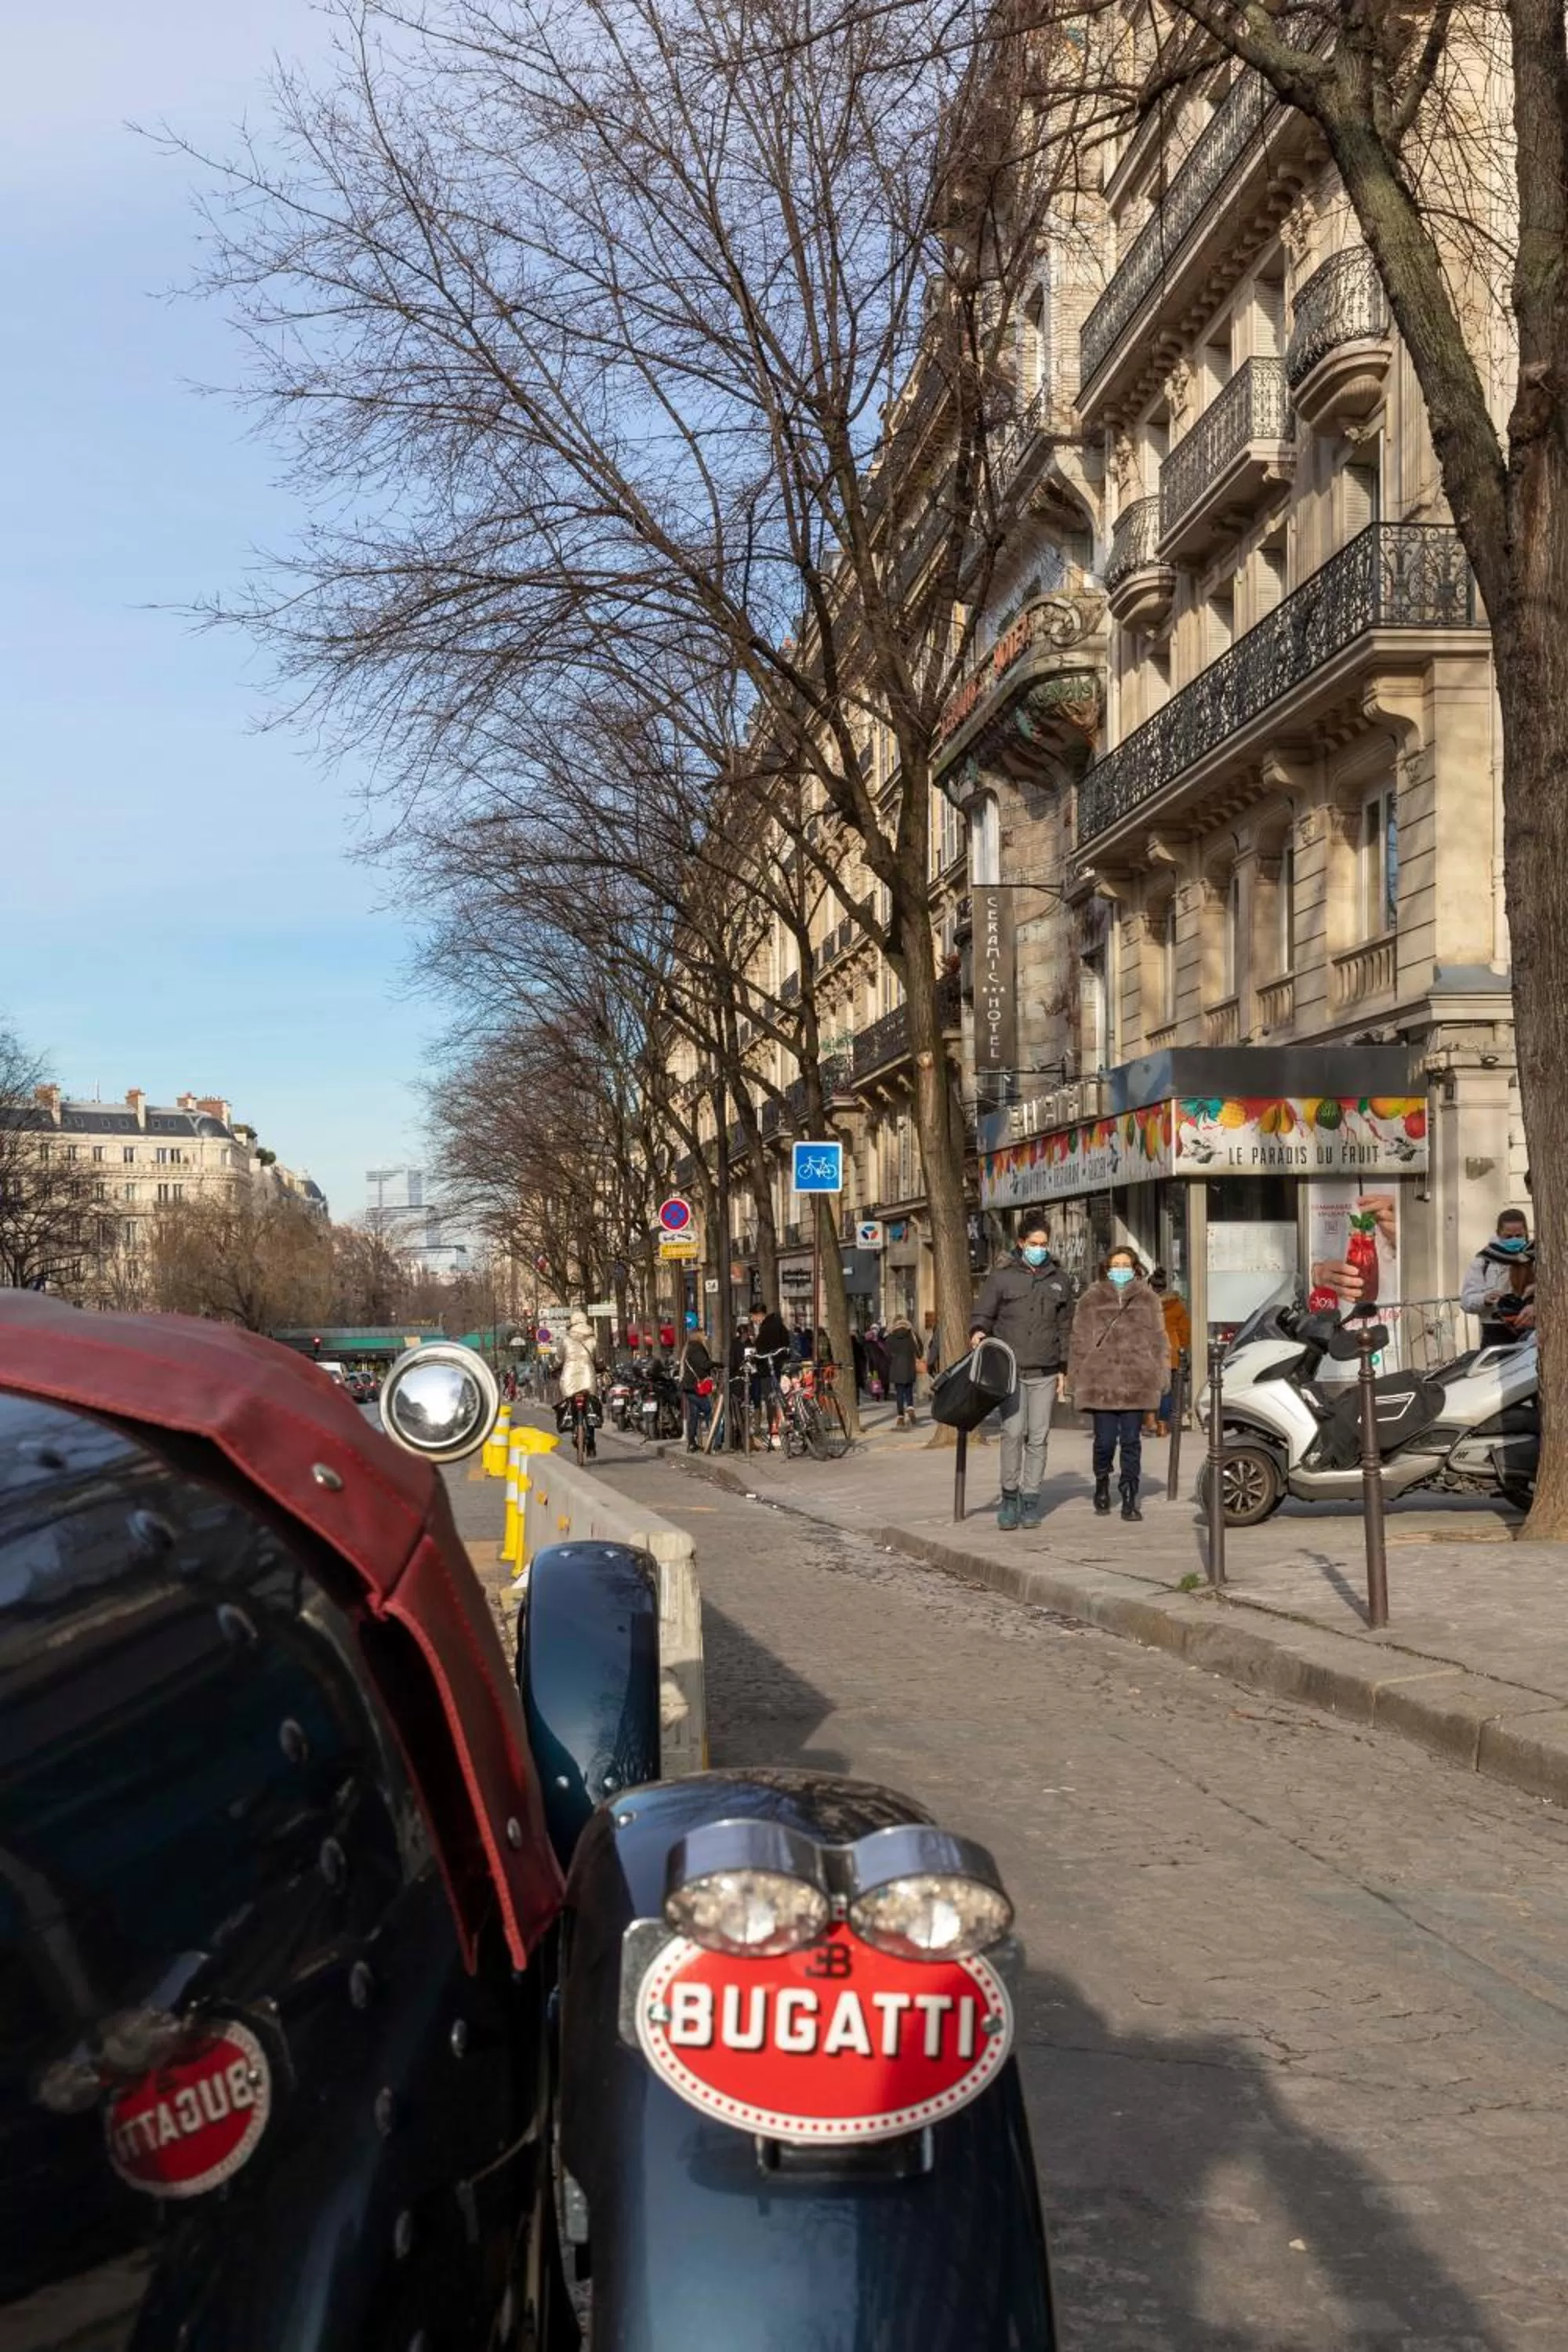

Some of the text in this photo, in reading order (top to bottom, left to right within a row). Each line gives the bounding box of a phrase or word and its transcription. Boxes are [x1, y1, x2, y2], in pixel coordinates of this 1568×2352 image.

[986, 896, 1001, 1058] CERAMIC HOTEL
[1229, 1145, 1380, 1166] LE PARADIS DU FRUIT
[669, 1981, 976, 2060] BUGATTI
